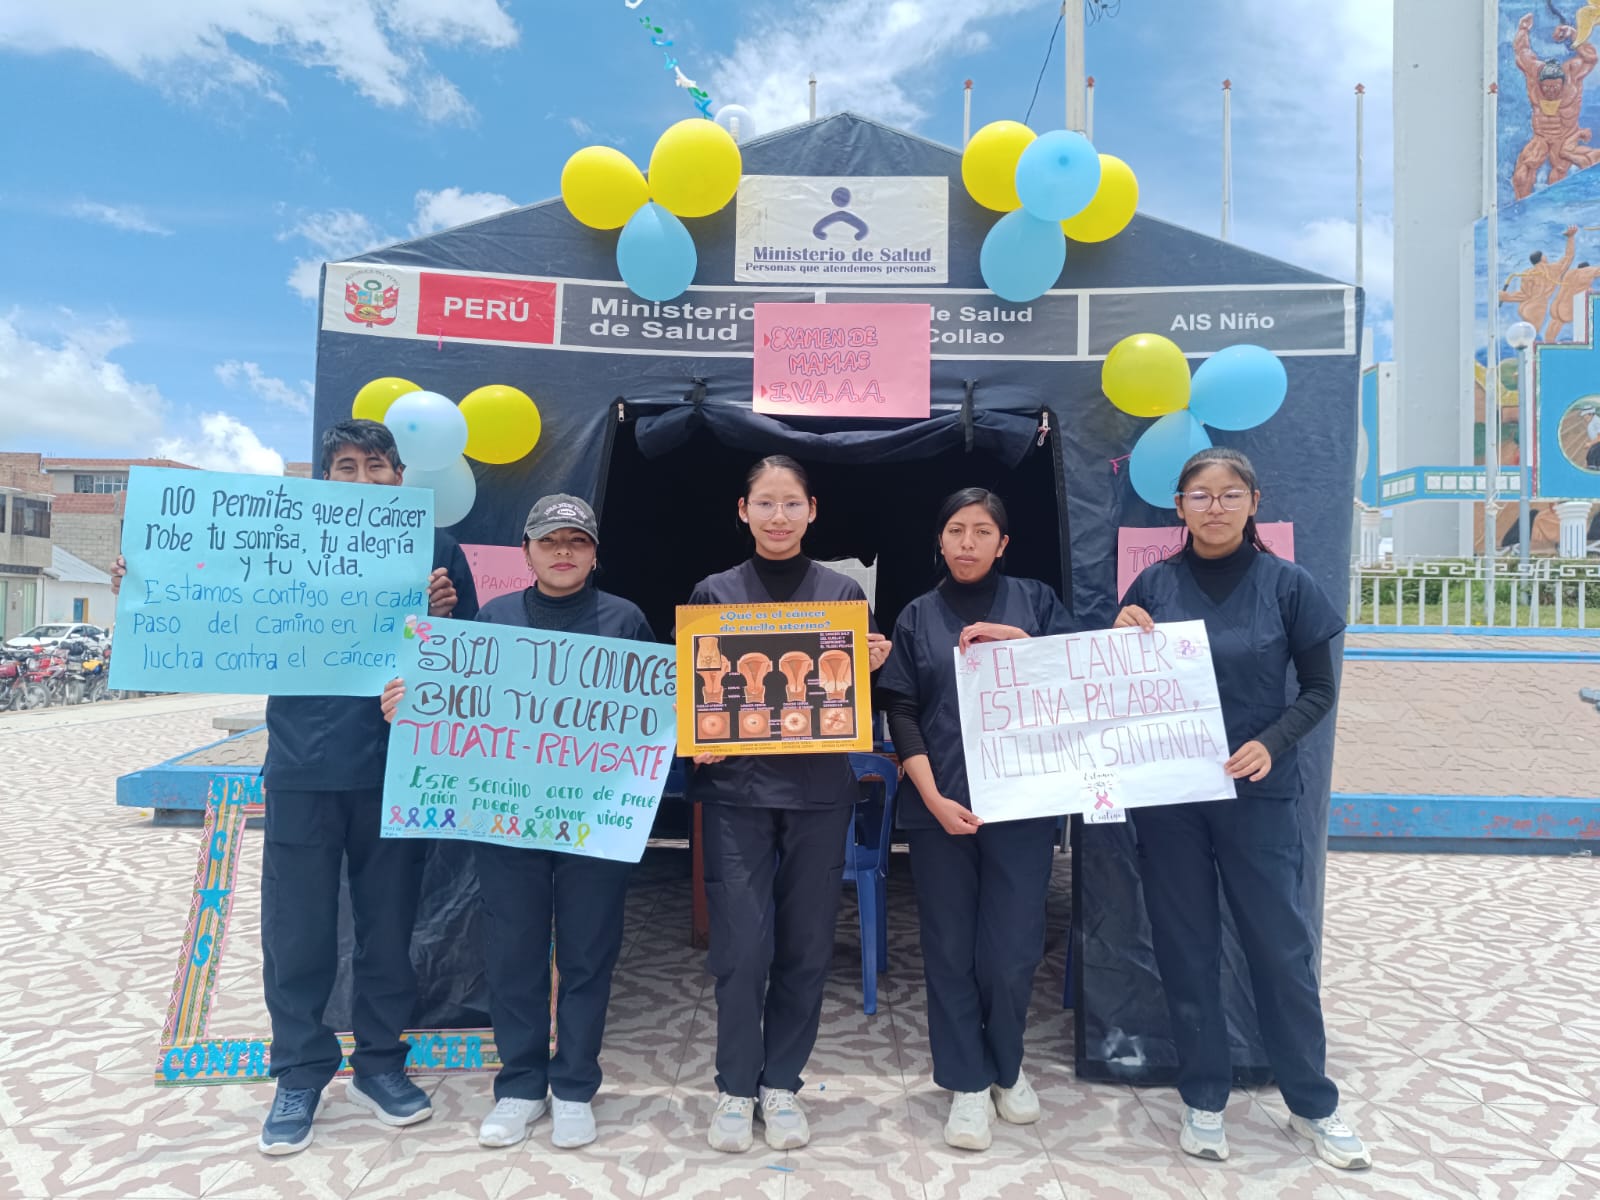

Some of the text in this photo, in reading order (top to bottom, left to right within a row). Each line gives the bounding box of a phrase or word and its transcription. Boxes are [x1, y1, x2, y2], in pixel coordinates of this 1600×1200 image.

[753, 246, 931, 262] Ministerio de Salud
[745, 263, 936, 274] Personas que atendemos personas
[443, 296, 529, 323] PERÚ
[591, 297, 755, 320] Ministerio
[960, 306, 1033, 322] Salud
[589, 319, 738, 340] de Salud
[1170, 313, 1275, 331] AIS Niño
[770, 326, 878, 352] EXAMEN DE
[789, 351, 871, 376] MAMAS
[161, 486, 195, 516] NO
[312, 502, 343, 526] que
[345, 498, 364, 527] el
[368, 497, 426, 528] cáncer
[145, 523, 414, 559] robe tu sonrisa, tu alegría
[264, 552, 292, 576] tu
[308, 553, 363, 577] vida.
[144, 573, 424, 608] Estamos contigo en cada
[208, 611, 238, 634] del
[332, 617, 357, 634] en
[373, 613, 395, 633] la
[720, 610, 752, 621] ¿Qué
[771, 610, 782, 619] el
[785, 609, 826, 618] cáncer
[720, 620, 831, 632] de cuello uterino?
[143, 644, 204, 669] lucha
[216, 644, 277, 670] contra
[288, 646, 306, 667] el
[418, 631, 677, 697] SÓLO TÚ CONOCES
[992, 630, 1173, 688] EL CANCER
[412, 682, 658, 736] BIEN TU CUERPO
[980, 690, 1011, 732] ES
[1016, 687, 1075, 728] UNA
[1038, 729, 1097, 774] UNA
[1100, 719, 1220, 767] SENTENCIA
[210, 775, 265, 806] SEM
[593, 785, 614, 800] de
[162, 1040, 271, 1081] CONTR
[406, 1035, 484, 1069] NCER
